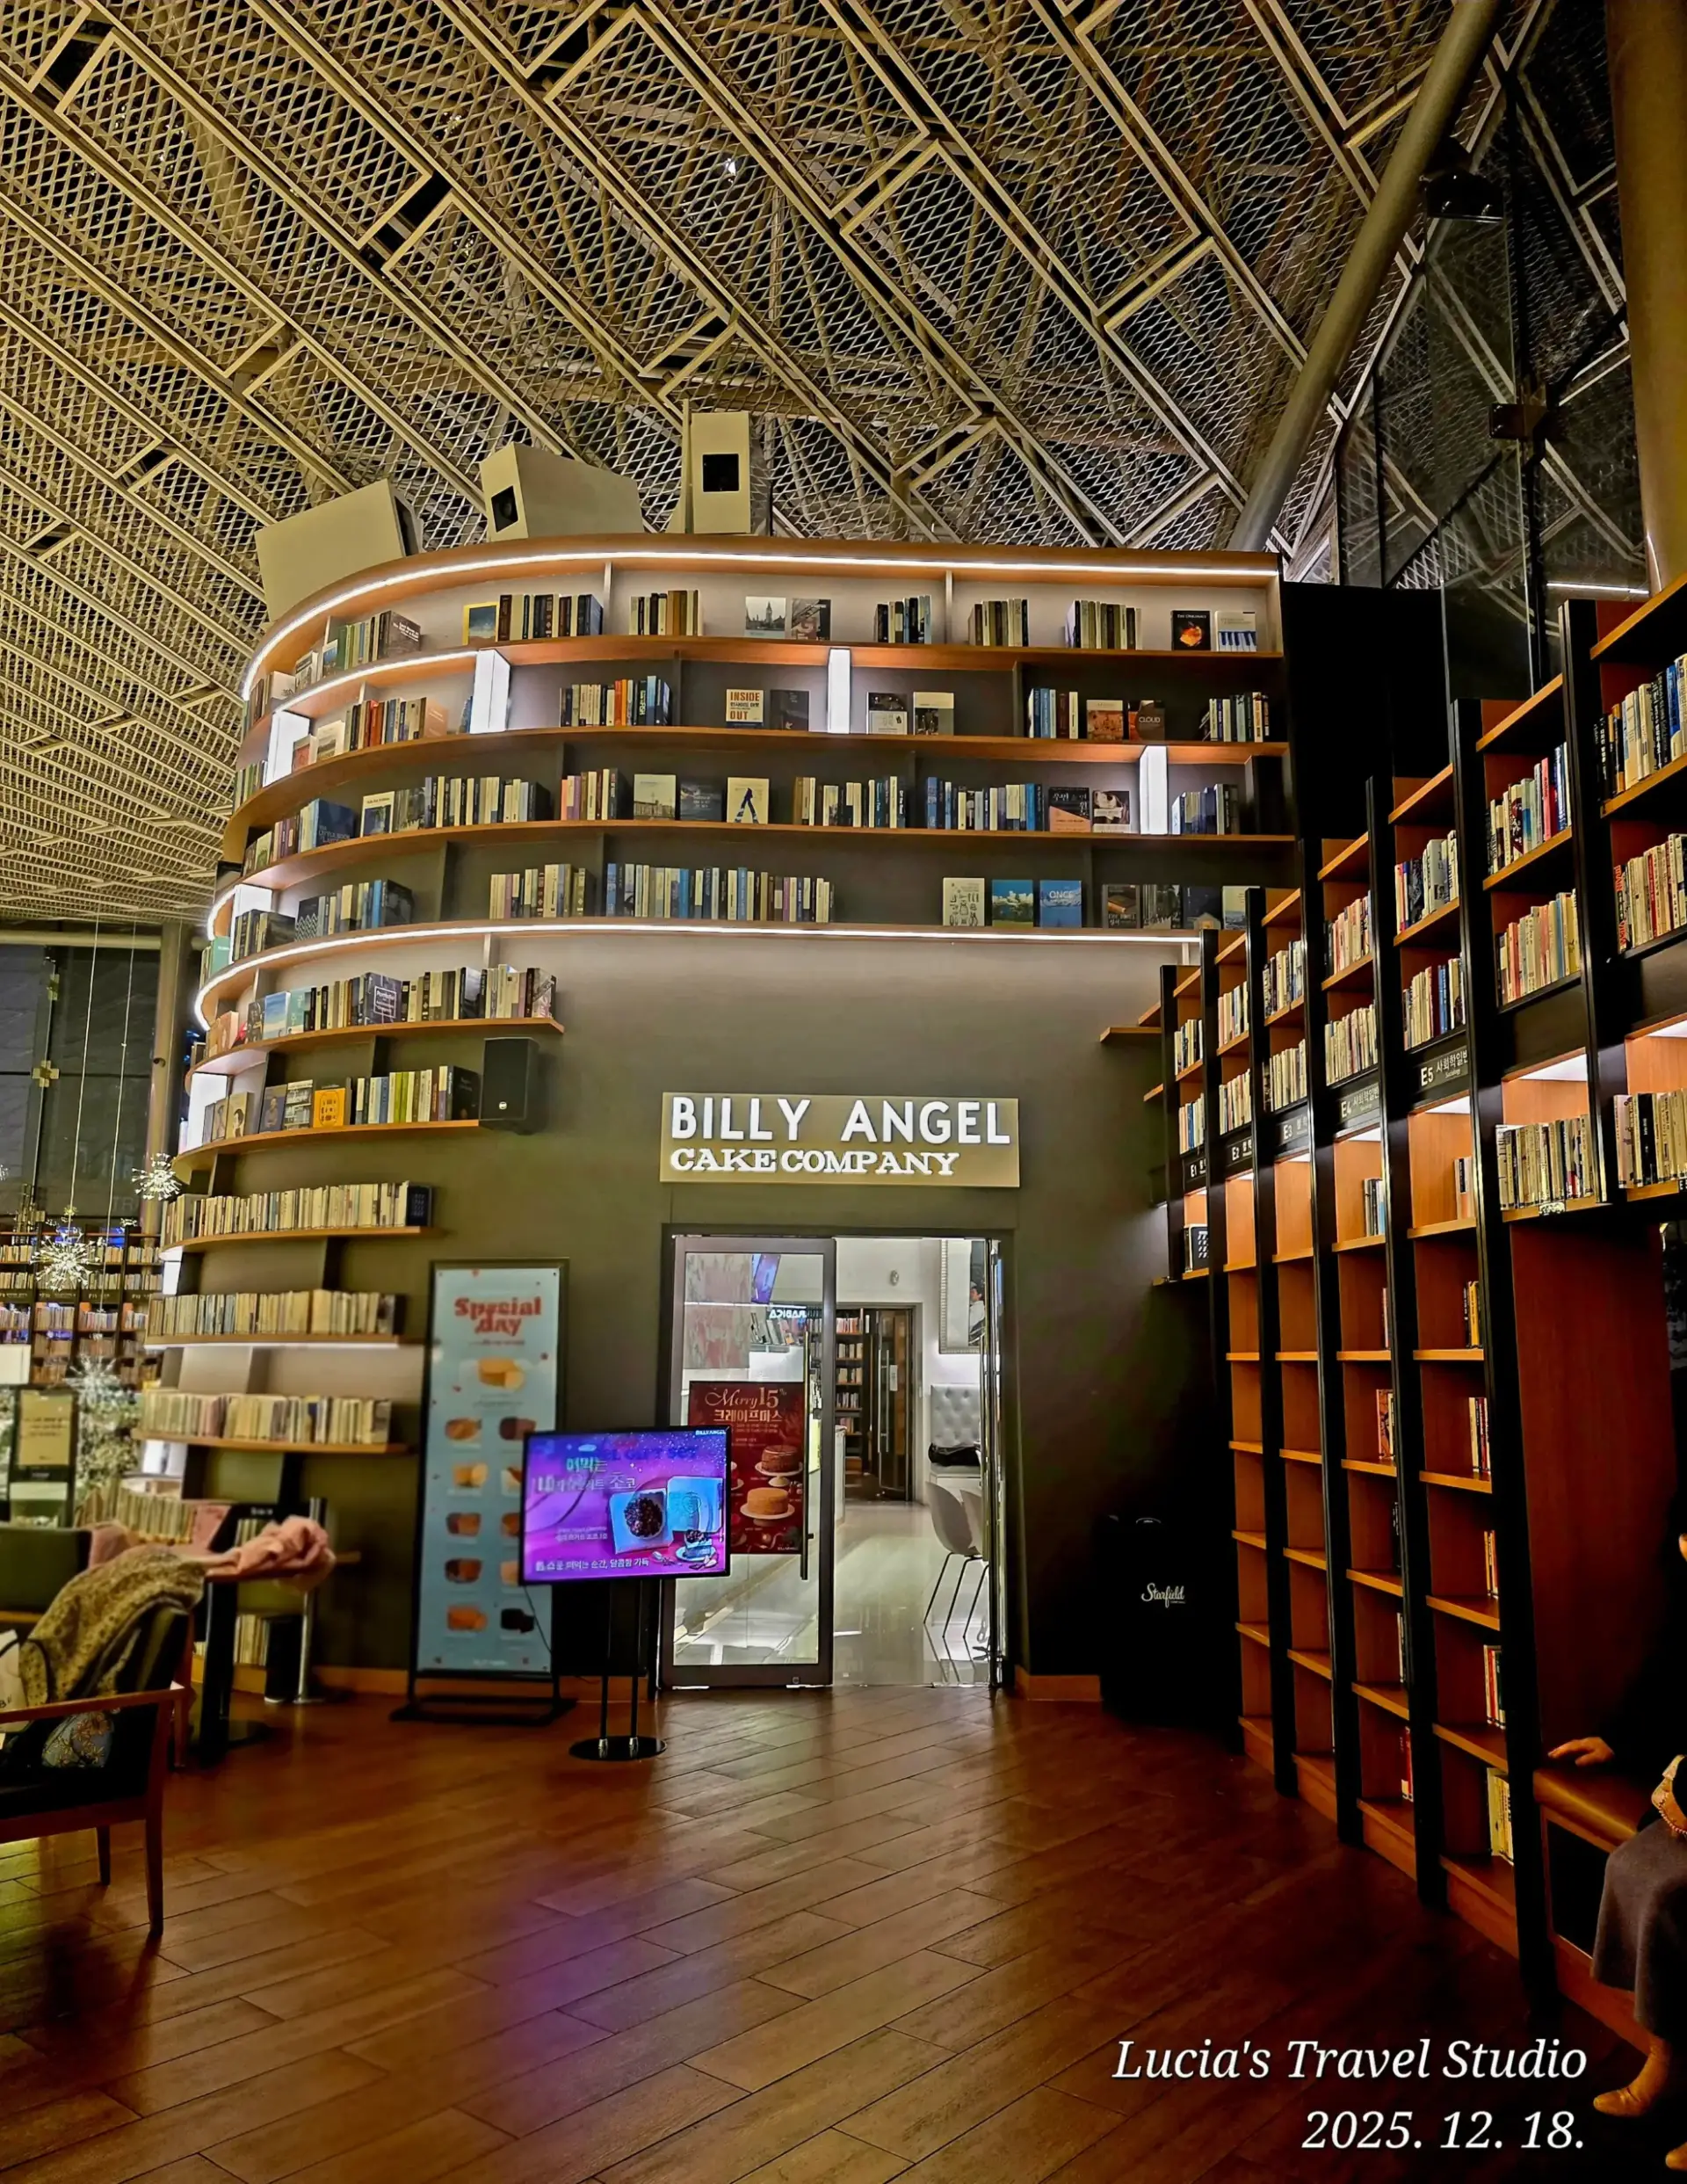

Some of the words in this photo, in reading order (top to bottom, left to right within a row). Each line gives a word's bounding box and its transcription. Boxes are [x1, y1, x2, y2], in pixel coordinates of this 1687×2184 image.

[730, 692, 760, 701] INSIDE
[730, 710, 748, 720] OUT
[1420, 1066, 1434, 1086] E5
[1341, 1100, 1351, 1118] E4
[671, 1096, 811, 1142] BILLY
[840, 1099, 1011, 1145] ANGEL
[670, 1148, 778, 1173] CAKE
[780, 1149, 960, 1176] COMPANY
[454, 1296, 542, 1321] Special
[706, 1389, 758, 1410] Merry
[713, 1409, 783, 1422] 크레이프마스
[1140, 1582, 1185, 1608] Starfield
